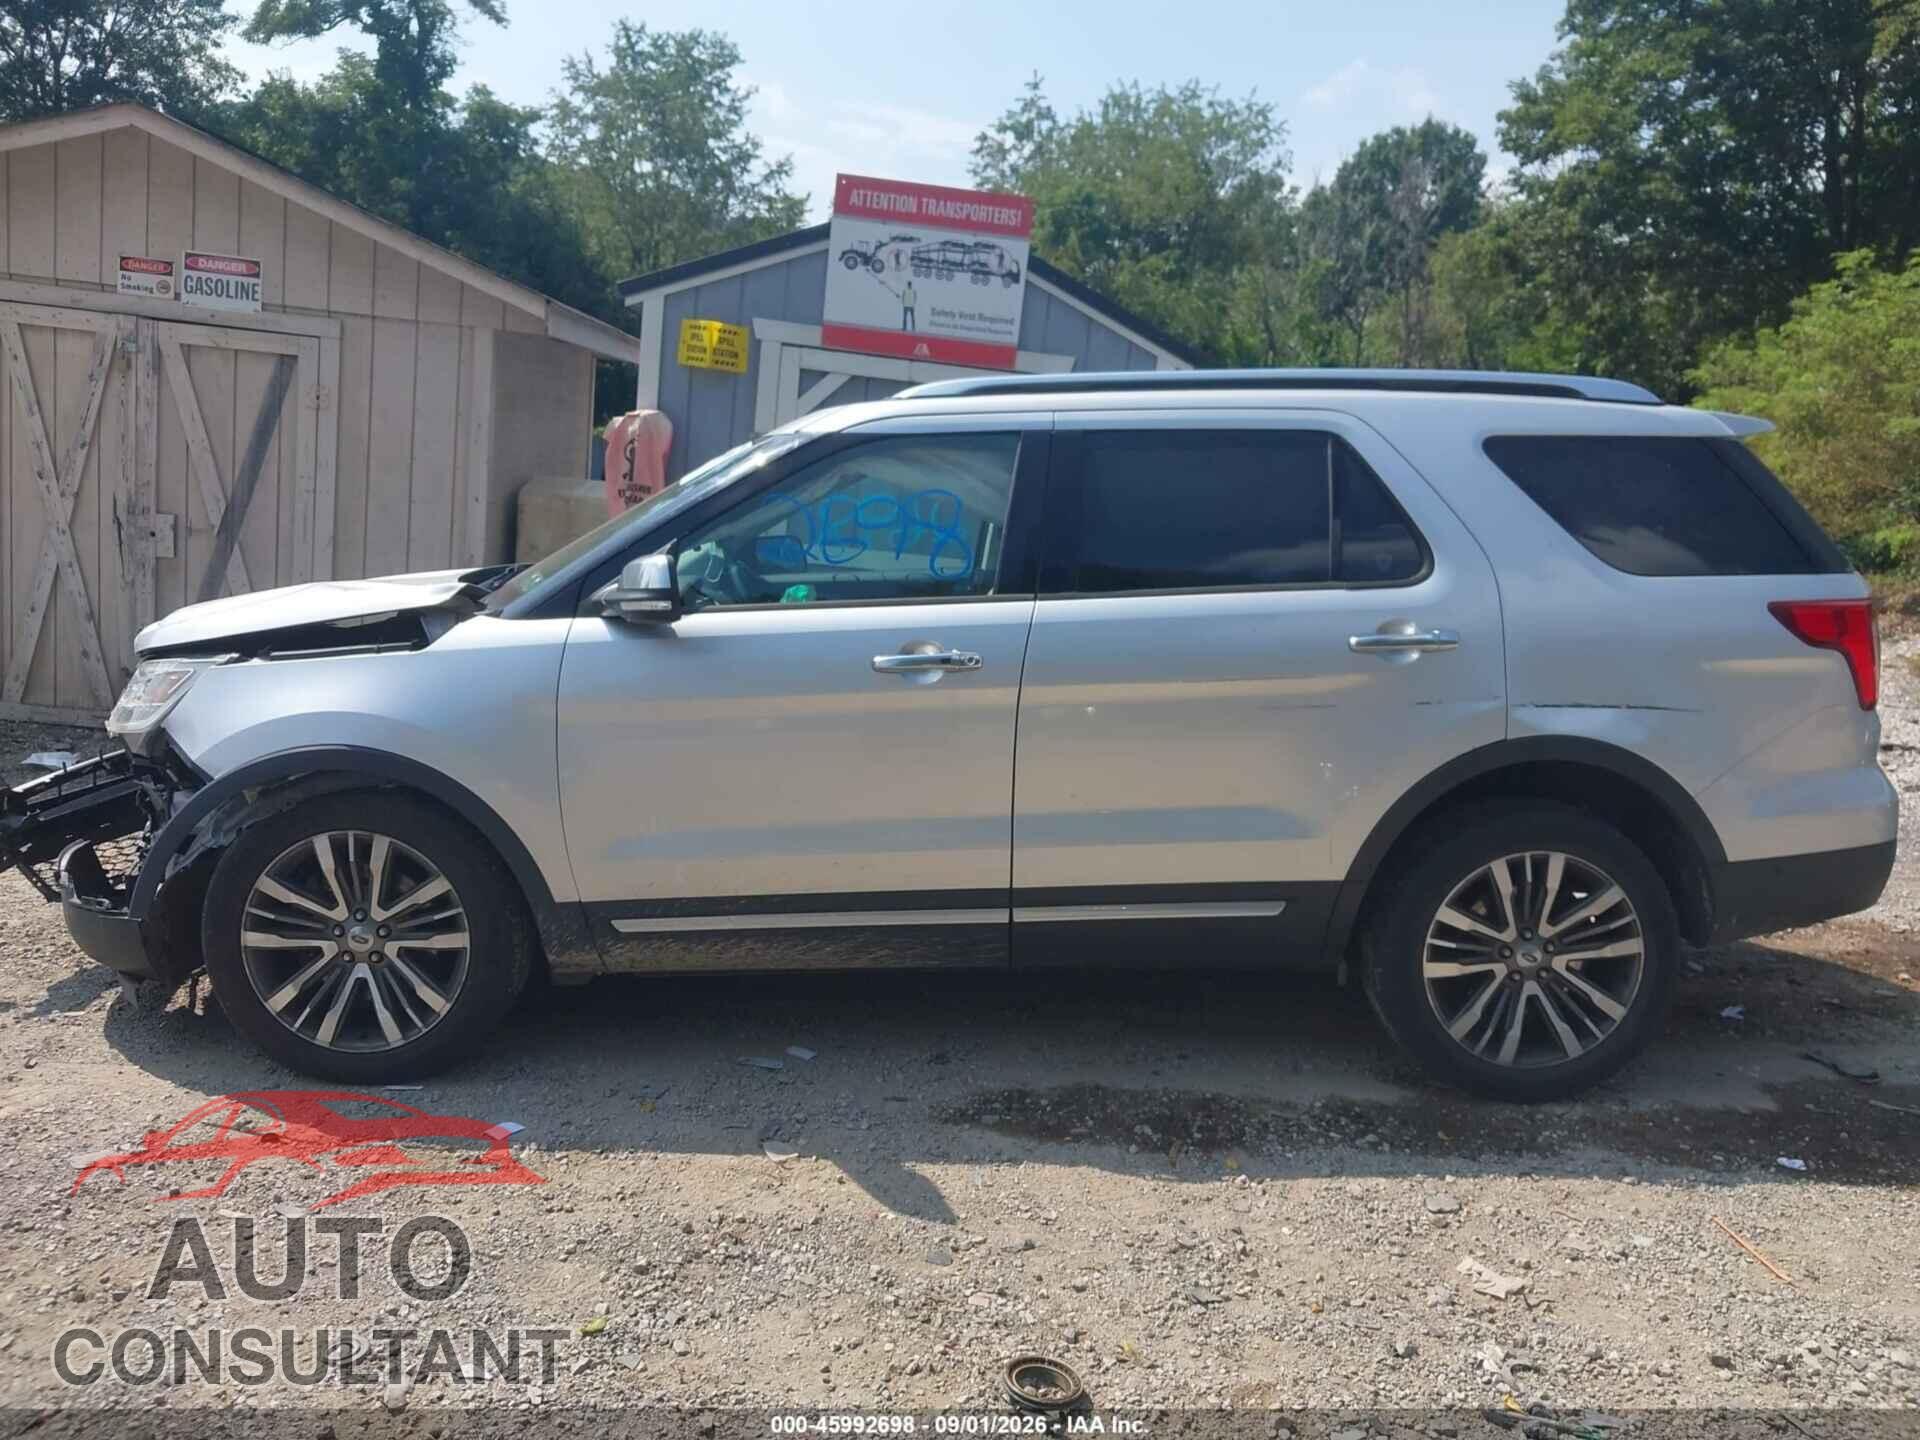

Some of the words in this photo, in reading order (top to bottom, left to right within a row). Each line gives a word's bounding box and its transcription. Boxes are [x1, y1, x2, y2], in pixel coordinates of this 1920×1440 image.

[849, 188, 917, 213] ATTENTION
[921, 197, 1023, 227] TRANSPORTERS!
[126, 258, 165, 272] DANGER
[198, 257, 248, 273] DANGER
[120, 273, 132, 282] No
[120, 281, 154, 295] Smoking
[183, 274, 260, 302] GASOLINE
[930, 306, 956, 320] Safety
